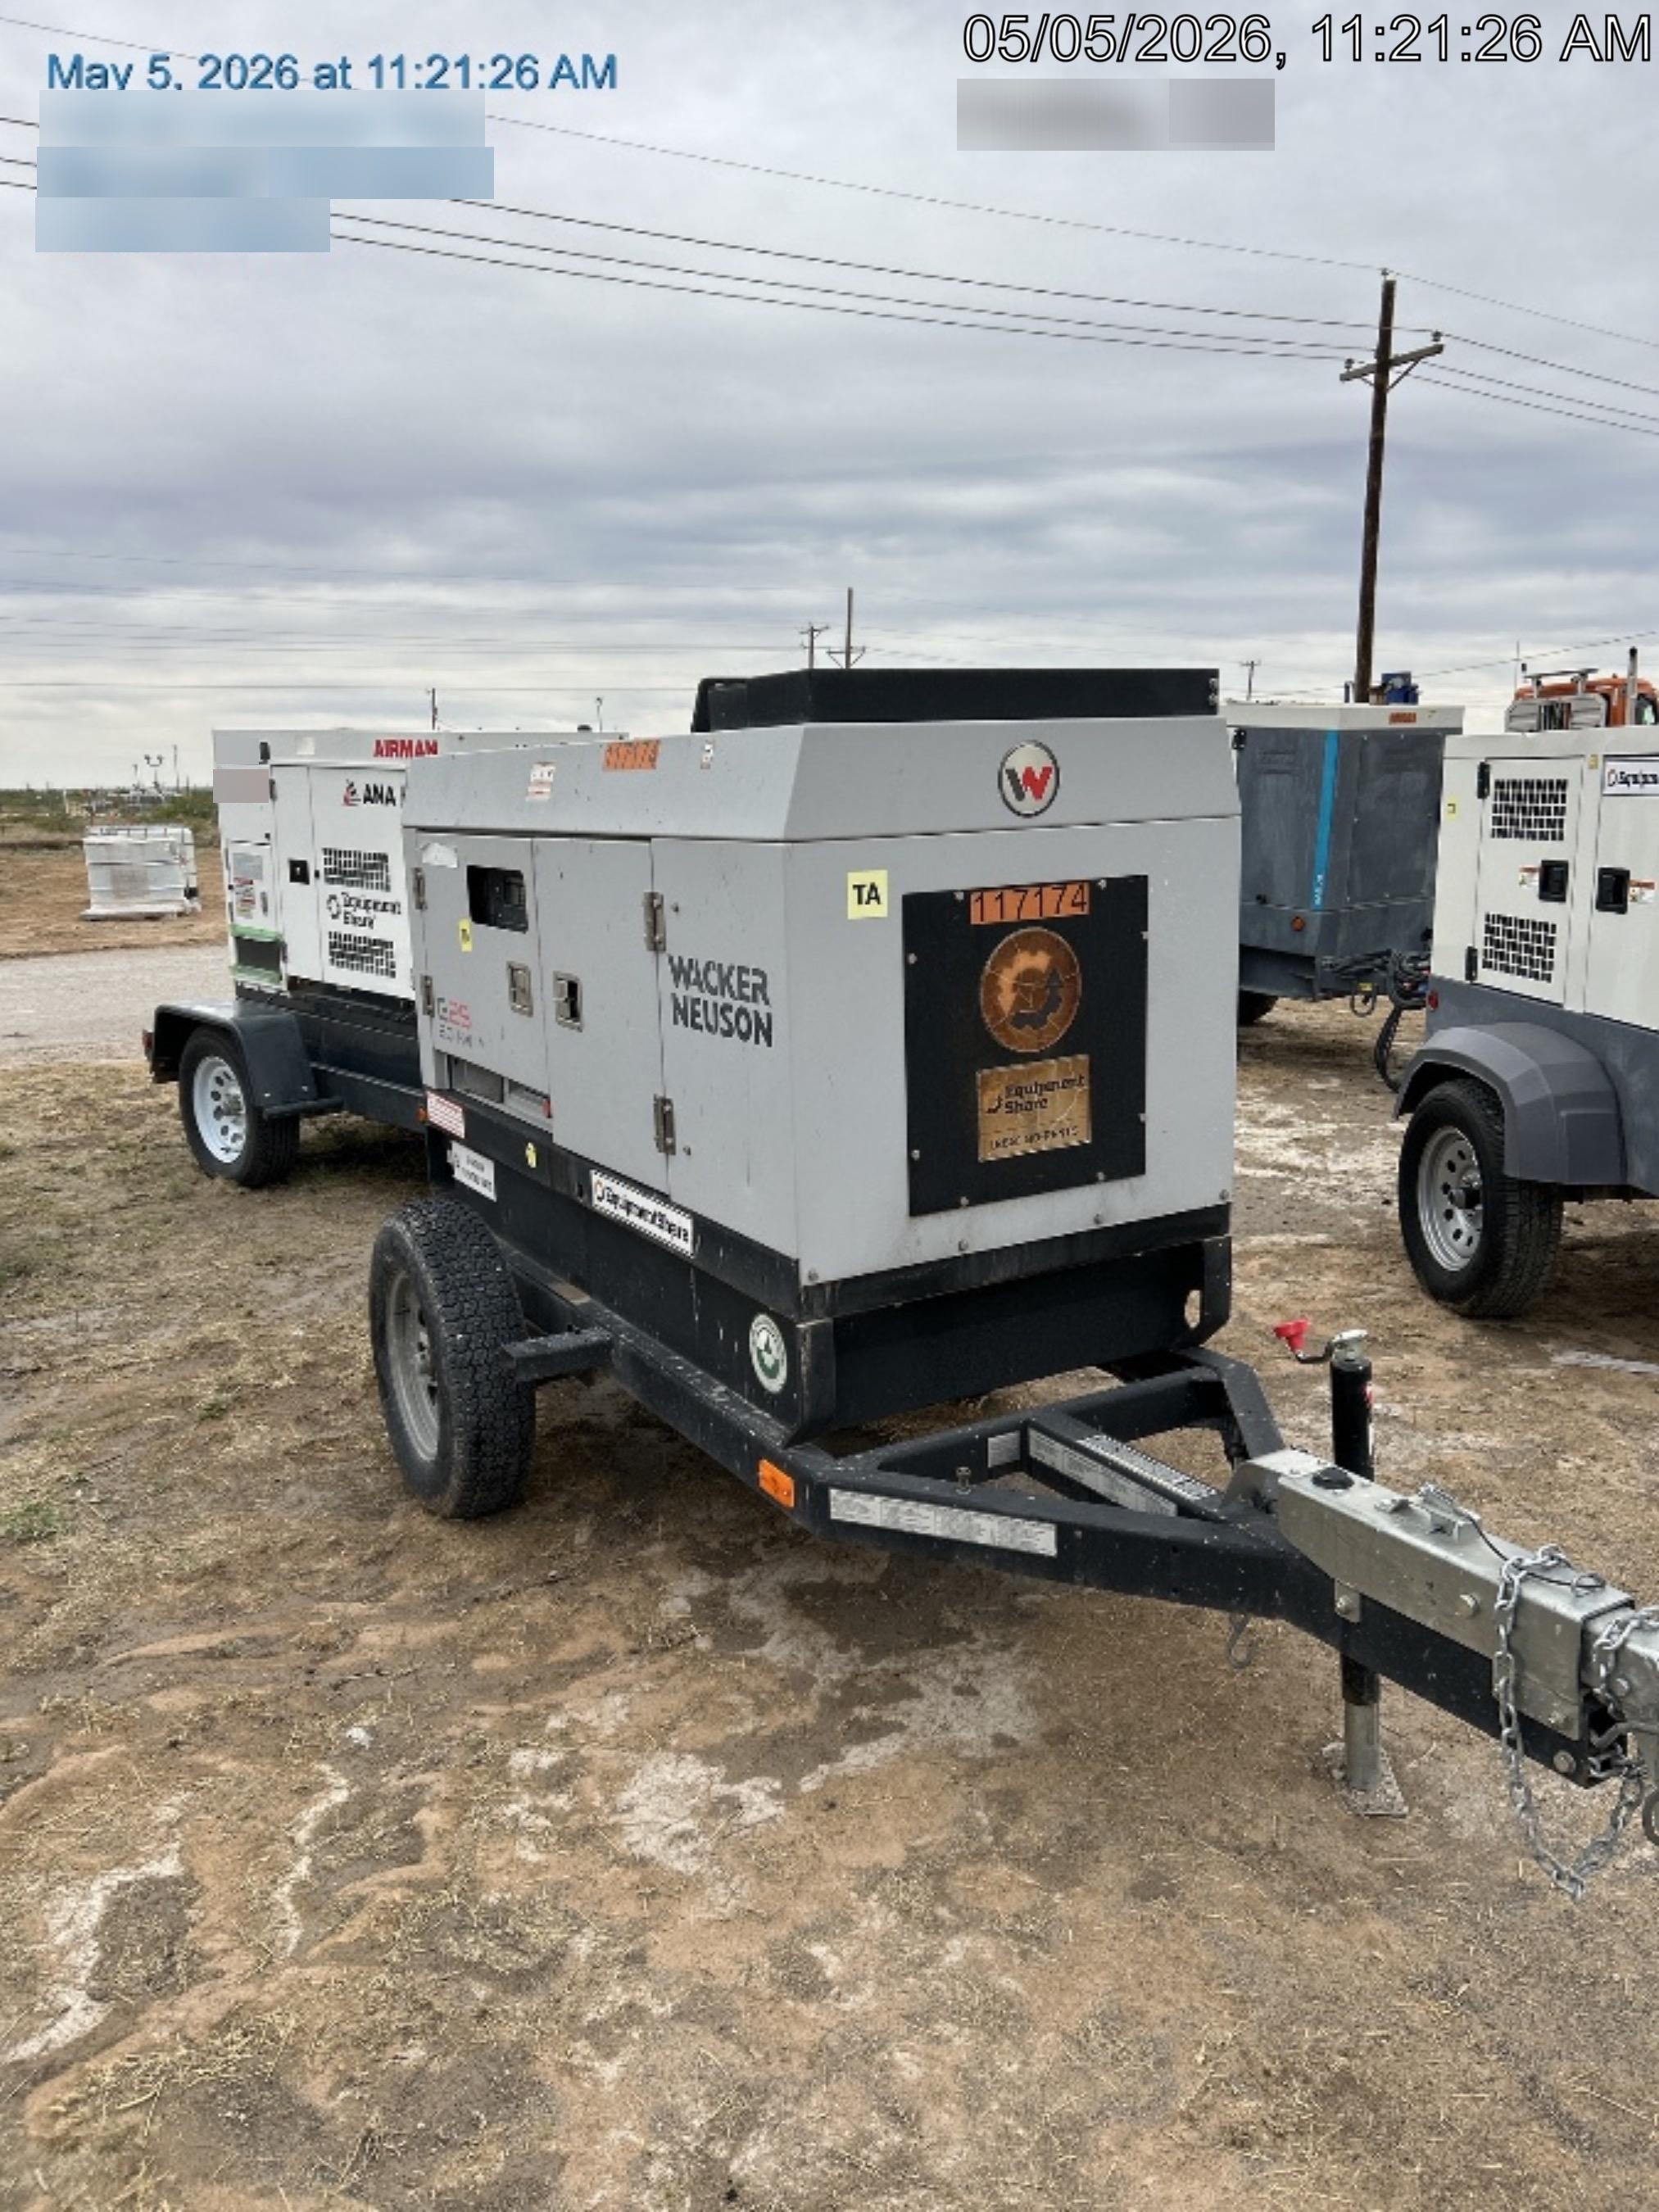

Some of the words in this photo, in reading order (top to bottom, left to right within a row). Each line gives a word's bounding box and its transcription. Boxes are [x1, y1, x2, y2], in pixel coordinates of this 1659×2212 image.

[374, 739, 438, 758] AIRMAN
[363, 783, 397, 806] ANA
[853, 882, 881, 905] TA
[974, 883, 1088, 922] 117174
[668, 954, 770, 1006] WACKER
[671, 992, 773, 1048] NEUSON
